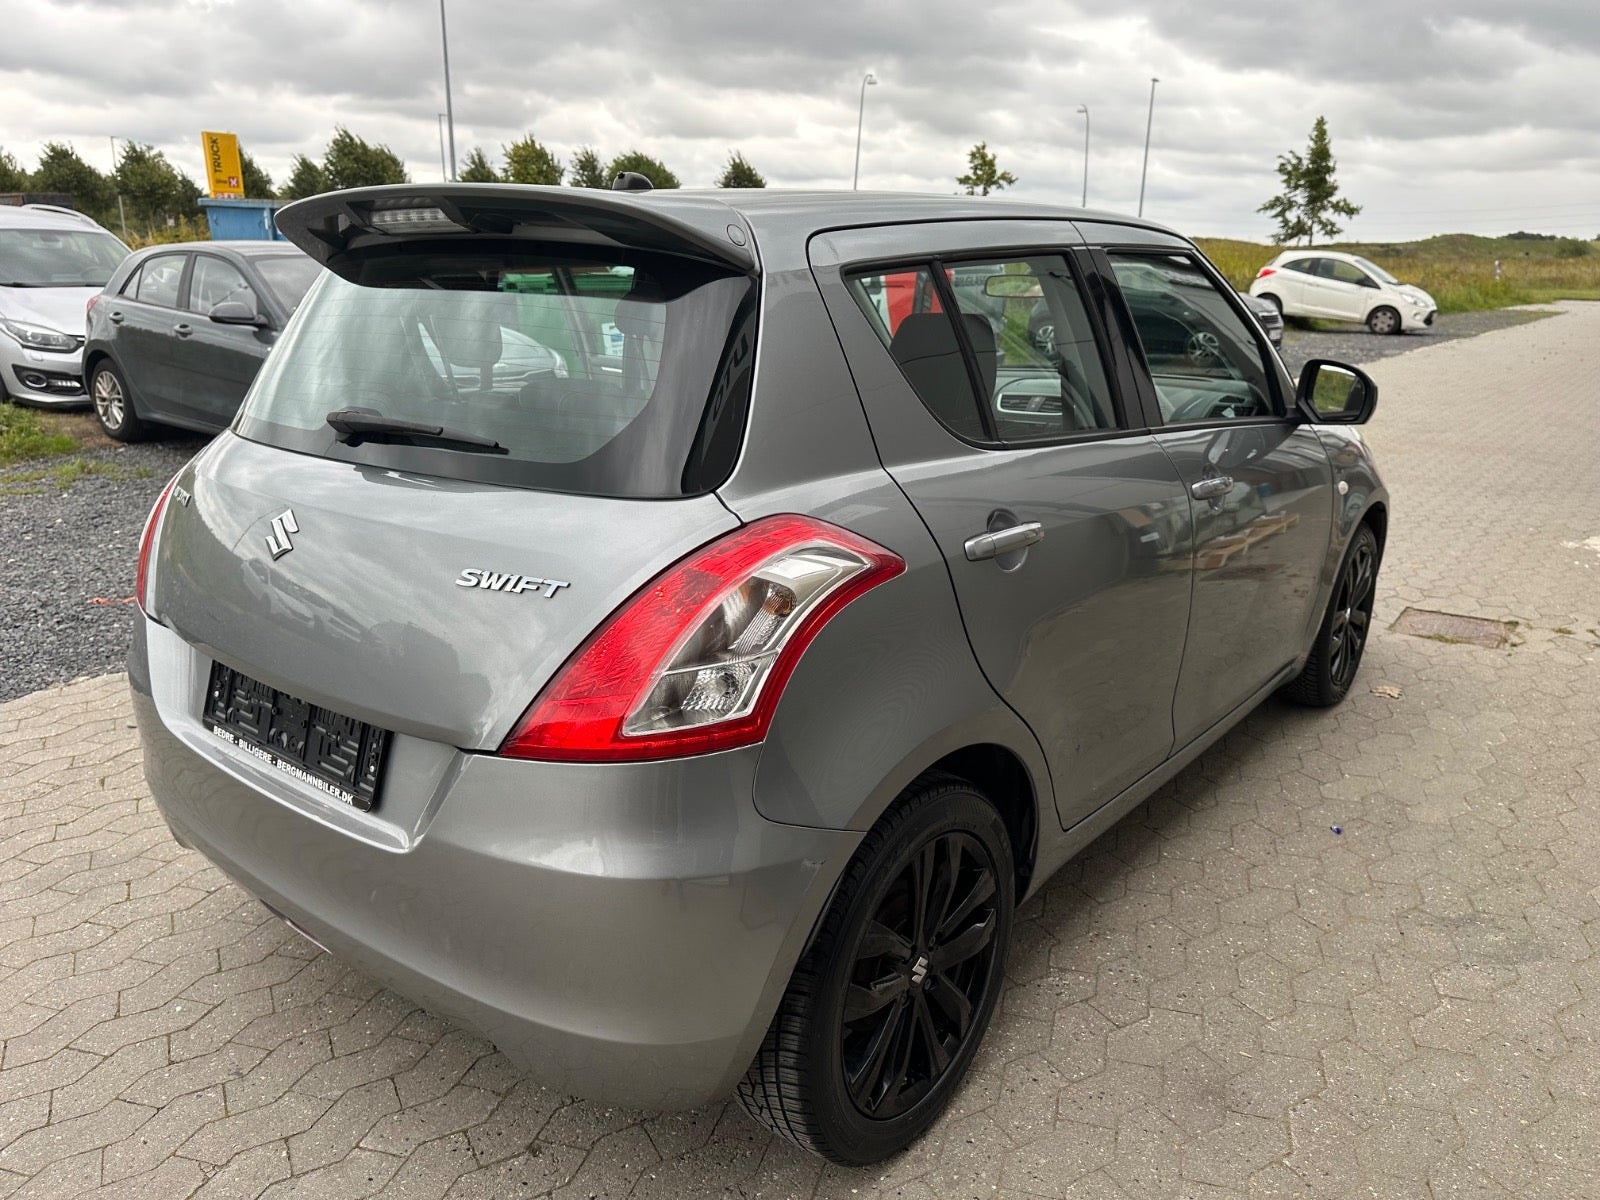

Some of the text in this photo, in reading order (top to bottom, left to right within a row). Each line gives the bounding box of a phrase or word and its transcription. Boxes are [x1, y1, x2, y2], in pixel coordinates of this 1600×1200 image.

[210, 136, 223, 173] TRUCK
[455, 568, 571, 598] SWIFT
[213, 725, 235, 744] BEDRE
[239, 740, 272, 764] BILLIGERE
[276, 760, 354, 805] BERGMANNBILER.DK
